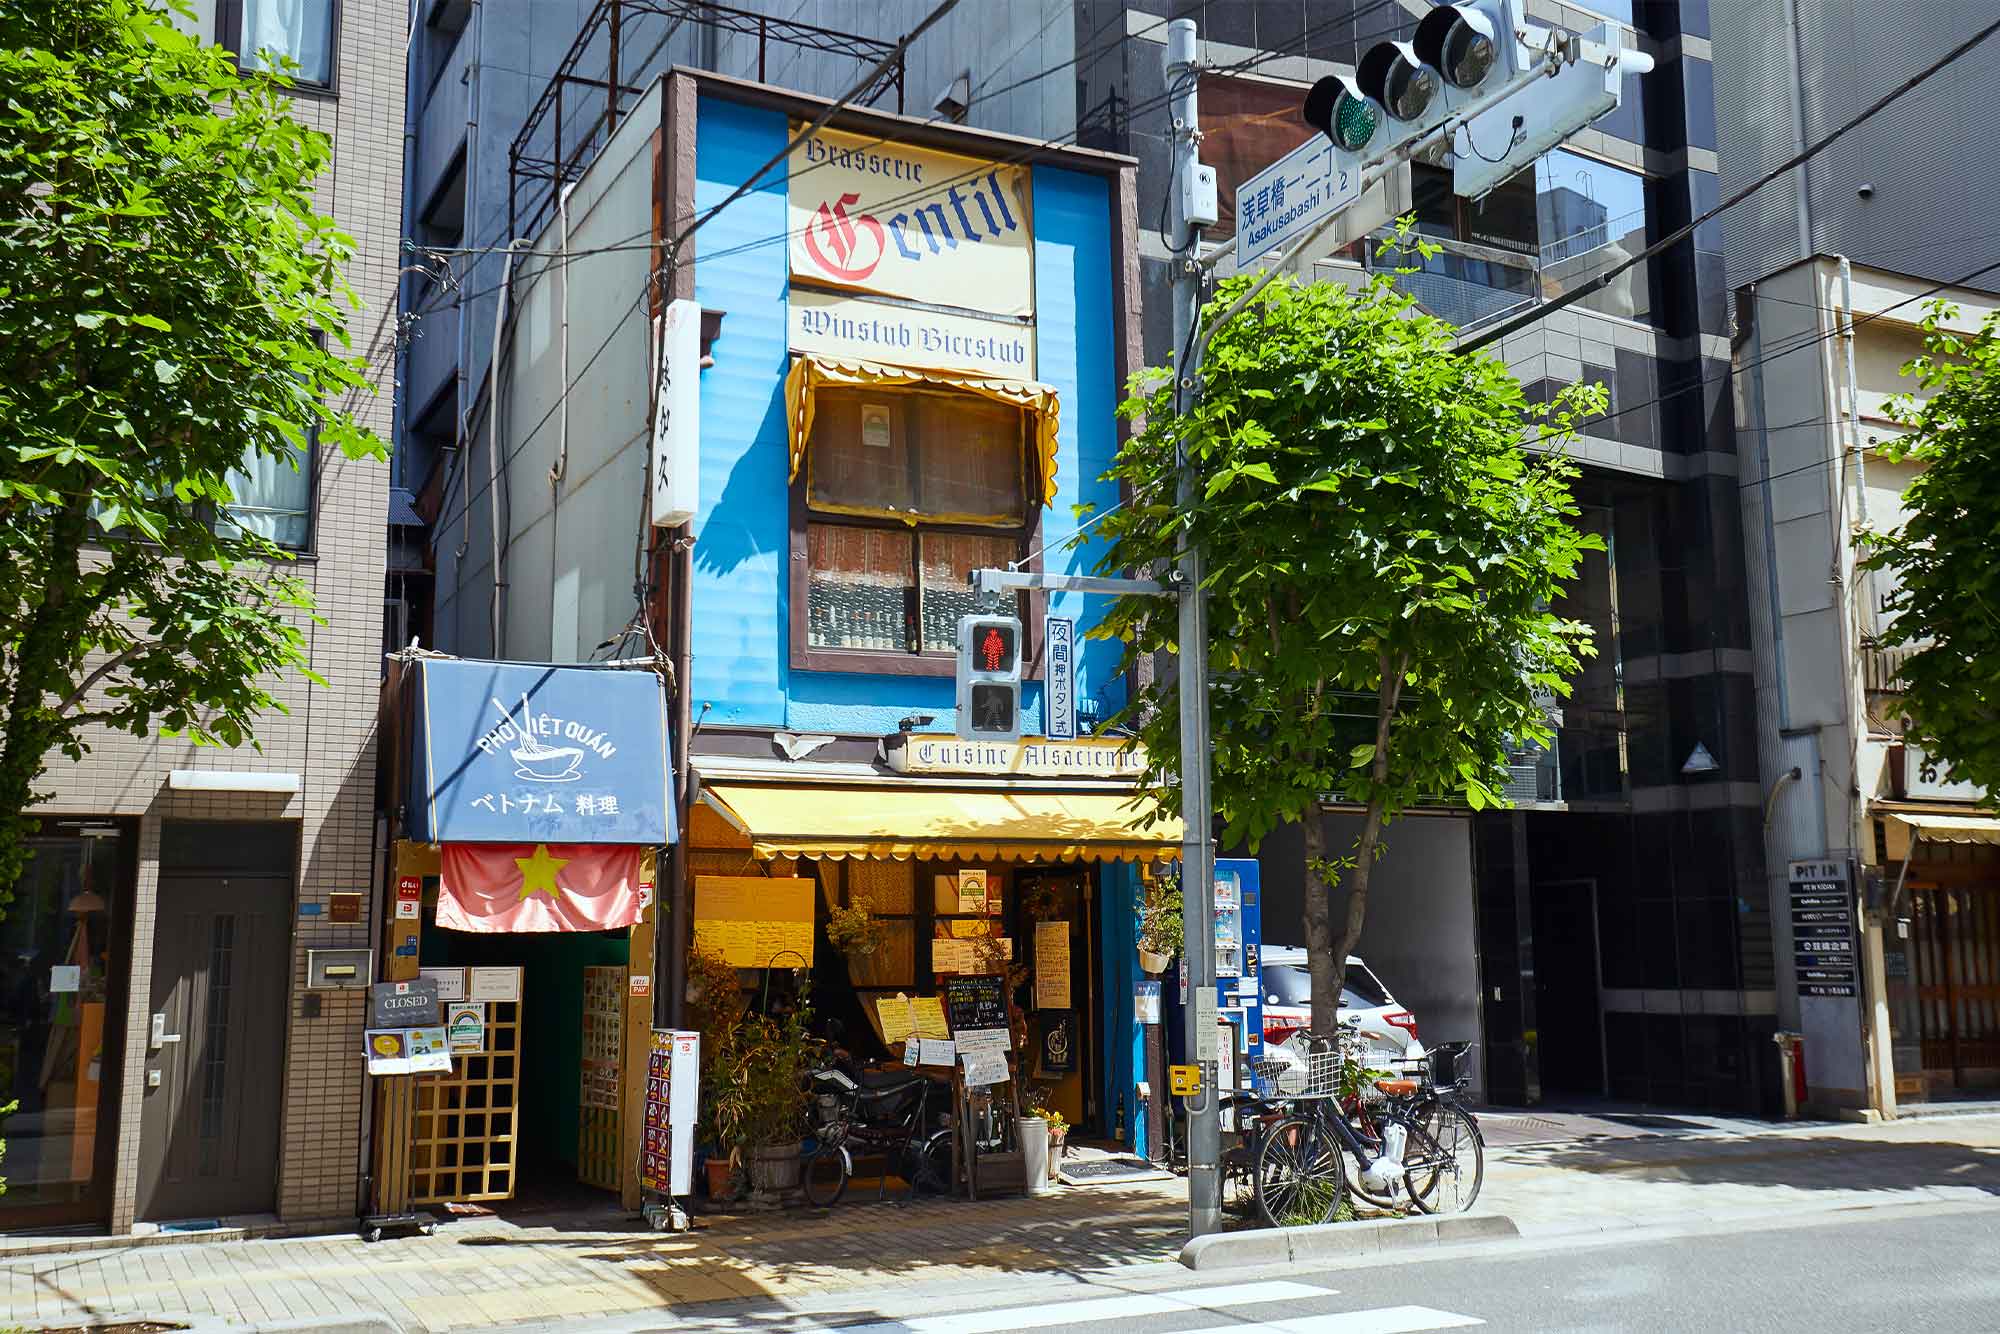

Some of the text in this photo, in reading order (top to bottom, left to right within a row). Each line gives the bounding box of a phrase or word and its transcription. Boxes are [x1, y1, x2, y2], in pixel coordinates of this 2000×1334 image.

[806, 138, 923, 183] Brasserie
[804, 170, 1017, 281] Gentil
[1247, 188, 1320, 248] Asakusabashi
[801, 309, 1025, 364] Winstub Bierstub
[1051, 623, 1068, 734] 夜間押ボタン式
[919, 742, 1007, 766] Cuisine
[471, 793, 620, 816] ベトナム 料理
[384, 995, 428, 1009] CLOSED
